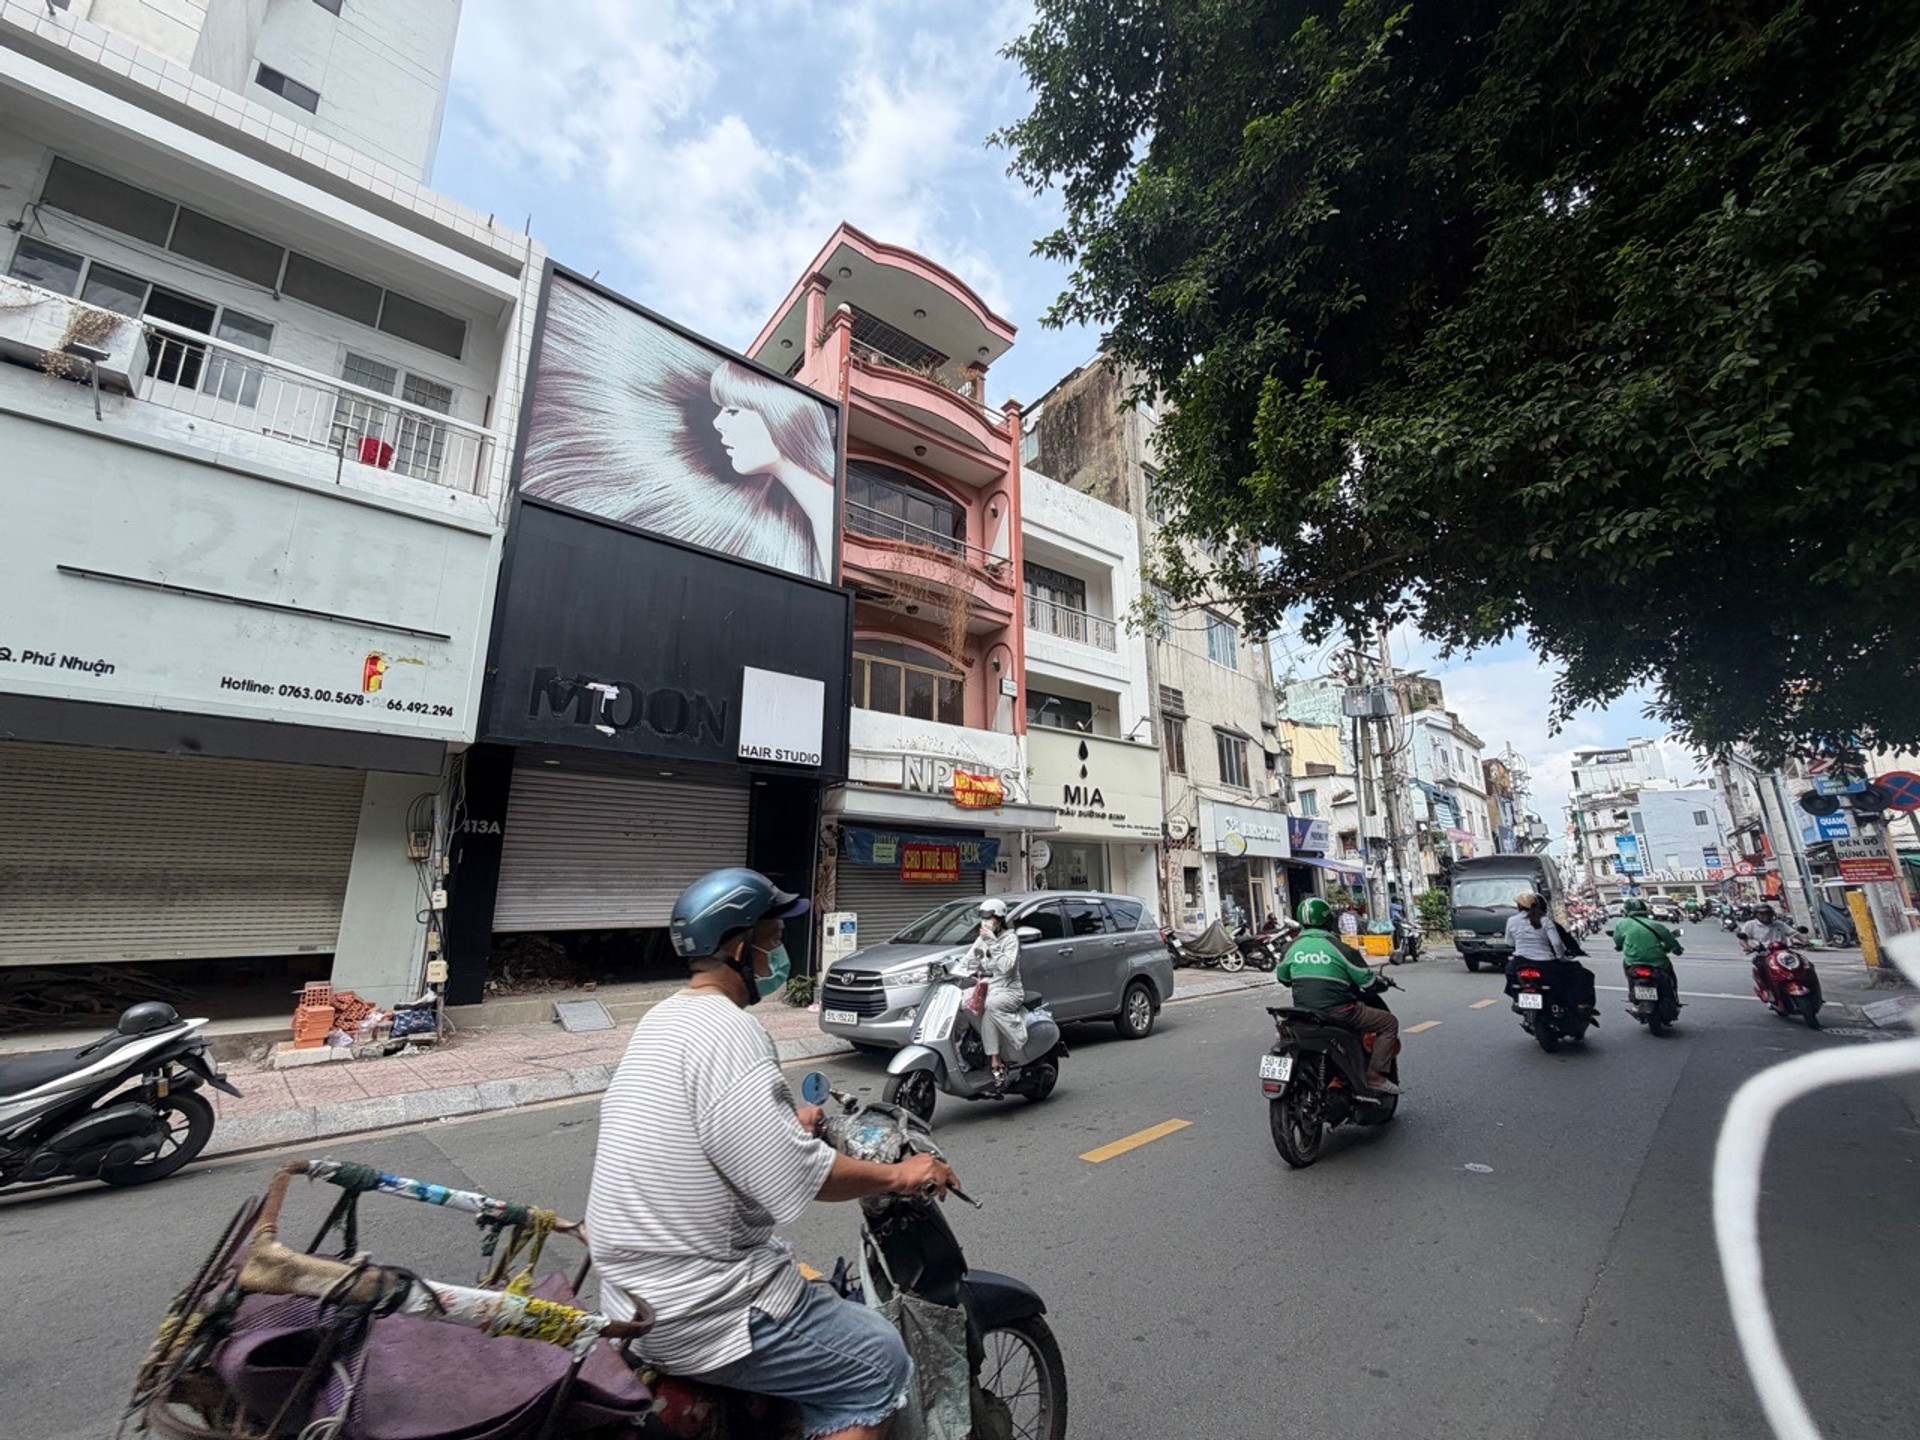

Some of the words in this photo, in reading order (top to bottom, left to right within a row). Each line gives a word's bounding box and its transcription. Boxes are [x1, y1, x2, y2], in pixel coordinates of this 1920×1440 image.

[21, 650, 56, 667] Phú
[59, 655, 116, 677] Nhuận
[220, 676, 275, 695] Hotline:
[278, 685, 365, 706] 0763.00.5678
[740, 744, 771, 759] HAIR
[774, 747, 820, 765] STUDIO
[902, 754, 1017, 803] NPS
[1063, 784, 1105, 809] MIA
[1294, 951, 1332, 965] Grab
